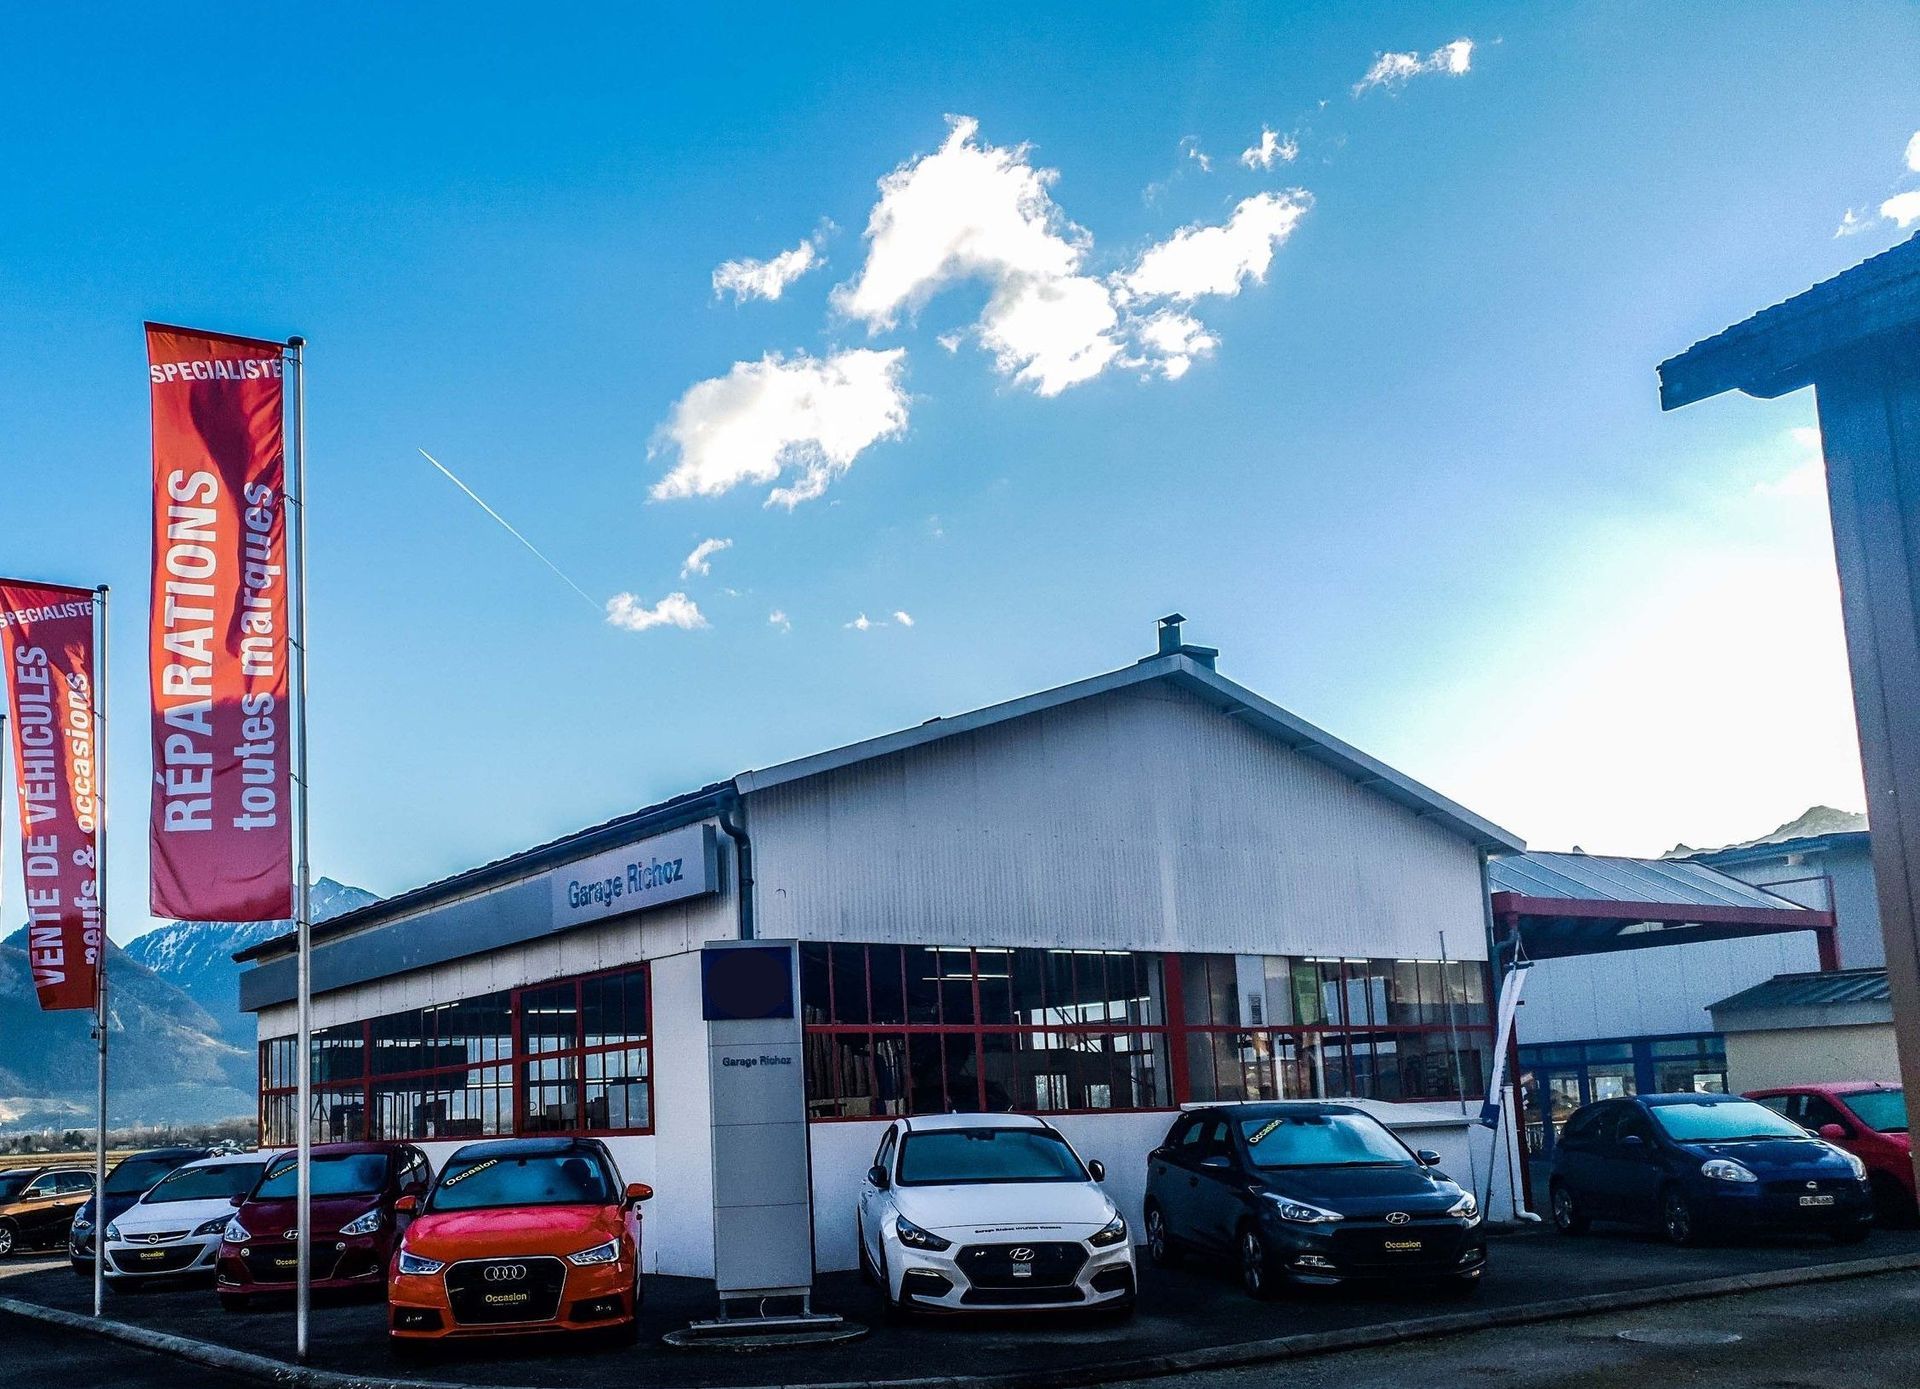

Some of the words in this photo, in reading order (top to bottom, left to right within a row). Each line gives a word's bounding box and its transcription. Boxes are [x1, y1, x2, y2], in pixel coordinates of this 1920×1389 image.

[150, 358, 282, 384] SPECIALISTE
[240, 481, 281, 677] marques
[0, 601, 93, 629] SPECIALISTE
[154, 469, 219, 832] RÉPARATIONS
[15, 644, 57, 825] VÉHICULES
[64, 671, 95, 834] occasions
[233, 692, 277, 831] toutes
[27, 834, 59, 877] DE
[72, 844, 96, 870] &
[568, 874, 623, 908] Garage
[626, 857, 684, 894] Richoz
[30, 883, 67, 988] VENTE
[722, 1057, 758, 1068] Garage
[759, 1055, 792, 1066] Richoz
[1249, 1119, 1283, 1143] Occasion
[446, 1158, 498, 1186] Occasion
[140, 1251, 165, 1259] Occasion
[1384, 1240, 1422, 1249] Occasion
[485, 1292, 527, 1303] Occasion
